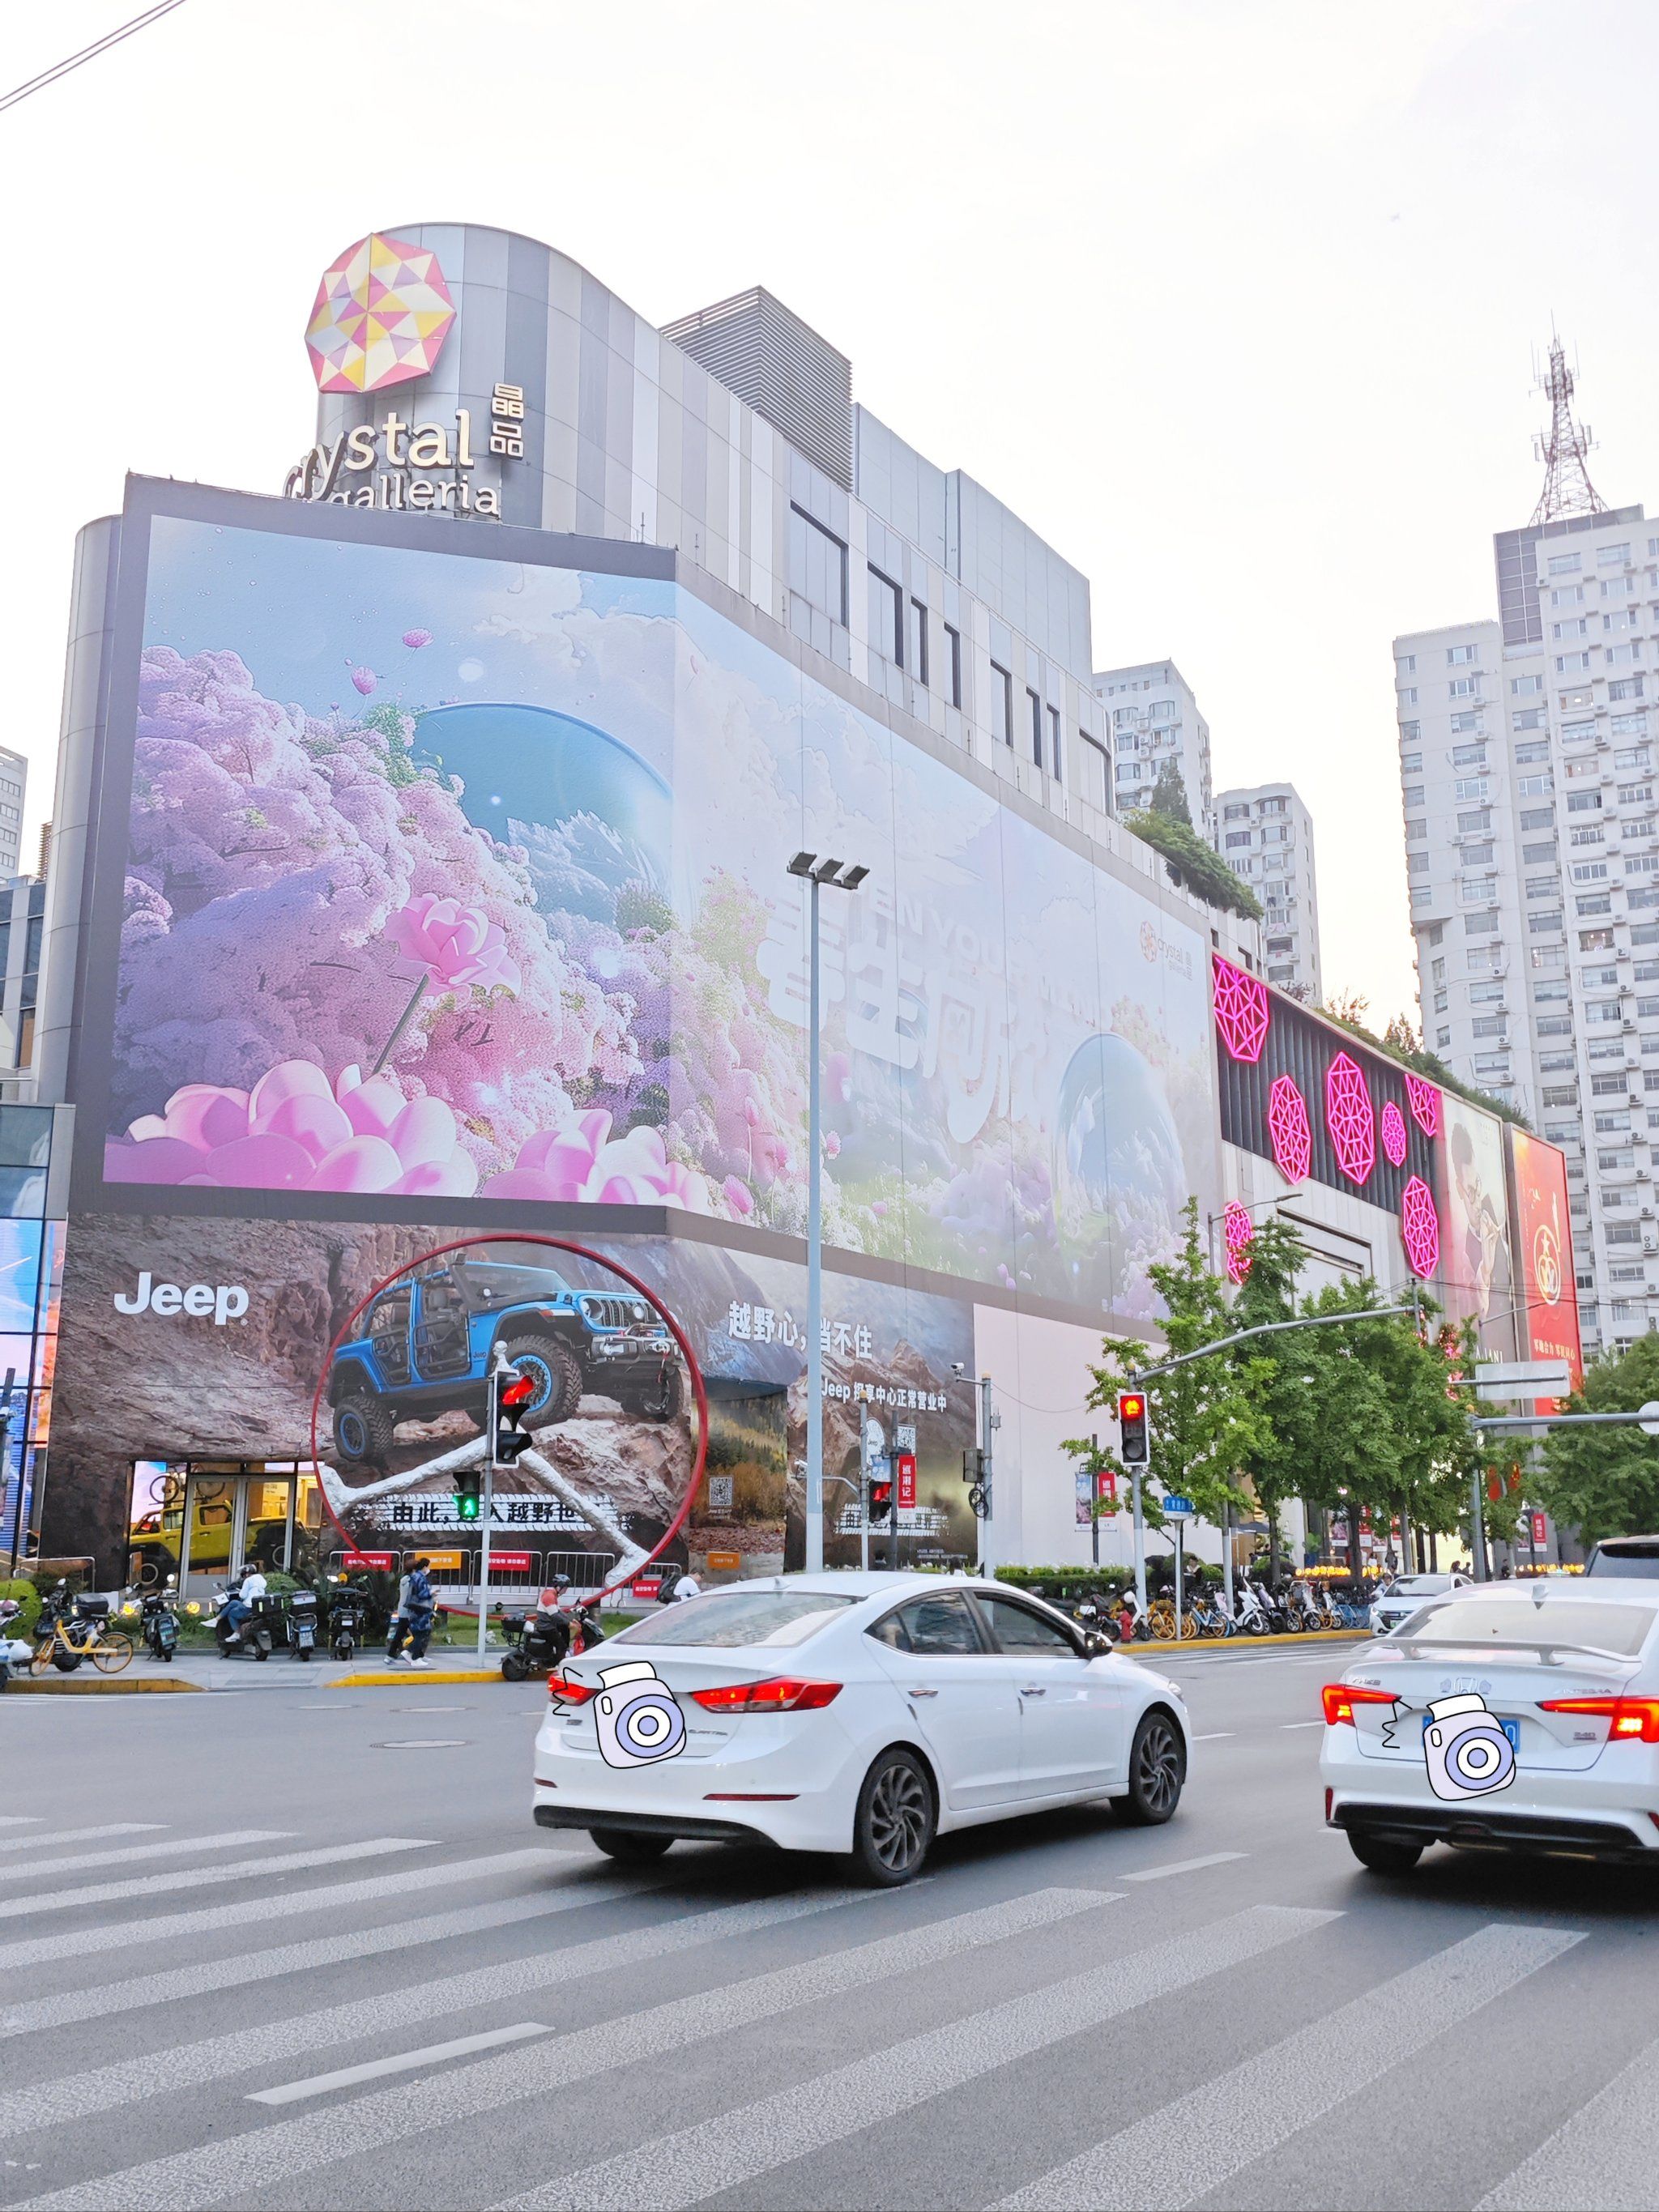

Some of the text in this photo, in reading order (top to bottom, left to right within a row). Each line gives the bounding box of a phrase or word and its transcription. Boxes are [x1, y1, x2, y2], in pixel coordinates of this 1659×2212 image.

[490, 382, 524, 460] 晶品
[114, 1272, 249, 1326] Jeep
[821, 1377, 851, 1404] Jeep
